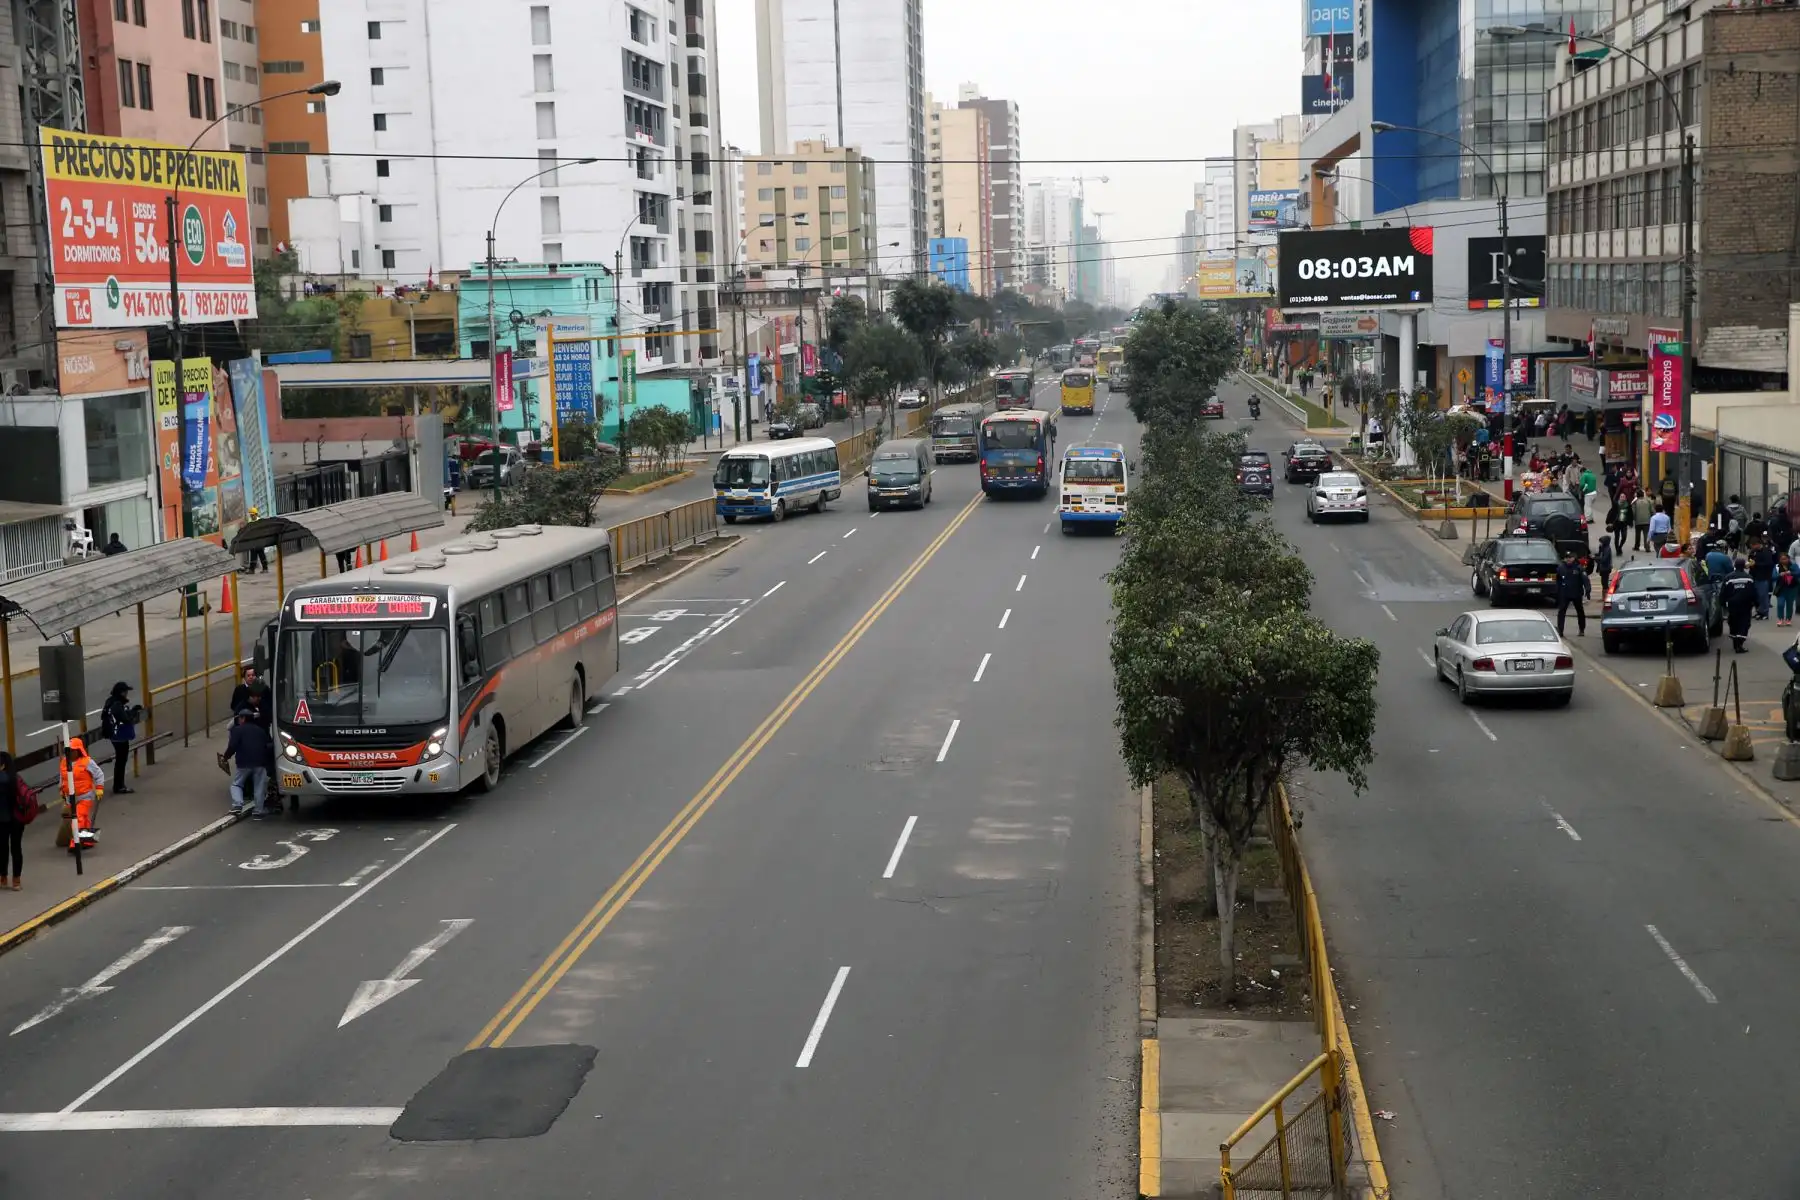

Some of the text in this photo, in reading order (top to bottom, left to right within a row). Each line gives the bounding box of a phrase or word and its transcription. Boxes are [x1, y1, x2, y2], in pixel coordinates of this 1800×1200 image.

[1311, 7, 1350, 24] paris
[52, 135, 241, 193] PRECIOS DE PREVENTA
[60, 196, 119, 239] 2-3-4
[132, 202, 157, 219] DESDE
[186, 218, 202, 245] ECO
[134, 222, 170, 263] 56 M2
[64, 244, 121, 262] DORMITORIOS
[1298, 255, 1415, 279] 08:03AM
[124, 292, 249, 316] 914 701 02 981 267 022
[1289, 295, 1329, 303] (01)209-8500
[73, 299, 91, 320] T&C
[183, 366, 208, 382] PRECIOS
[158, 389, 170, 406] DE
[310, 596, 353, 604] CARABAYLLO
[293, 699, 312, 723] A
[328, 752, 398, 761] TRANSNASA
[284, 777, 302, 787] 1702
